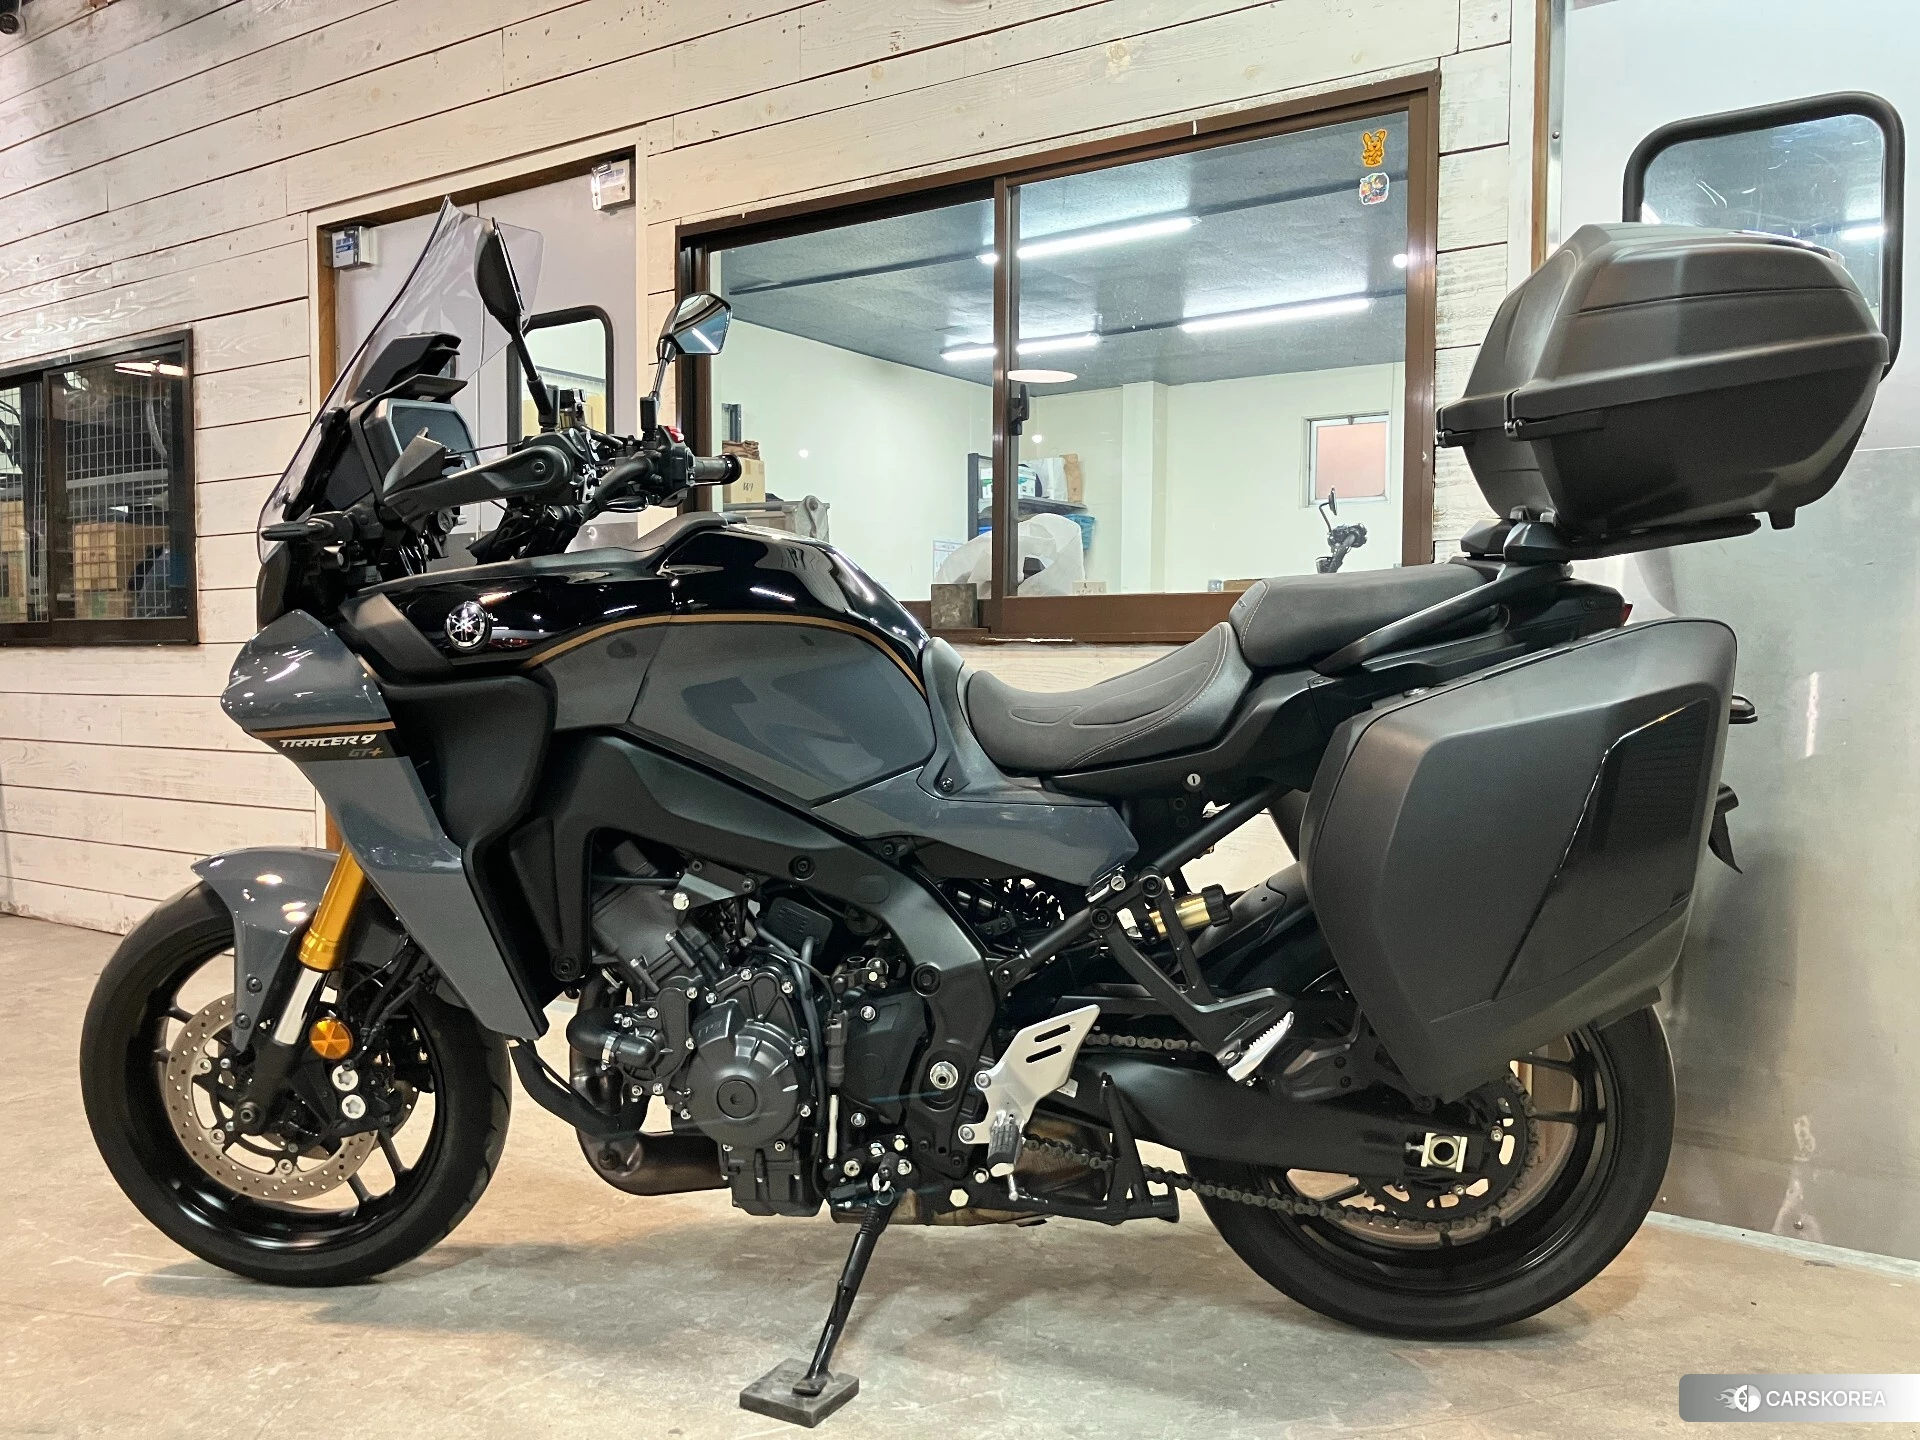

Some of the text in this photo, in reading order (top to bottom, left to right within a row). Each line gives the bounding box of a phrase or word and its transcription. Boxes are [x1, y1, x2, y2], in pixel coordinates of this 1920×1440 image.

[280, 733, 377, 748] TRACER 9
[348, 747, 384, 757] GT+
